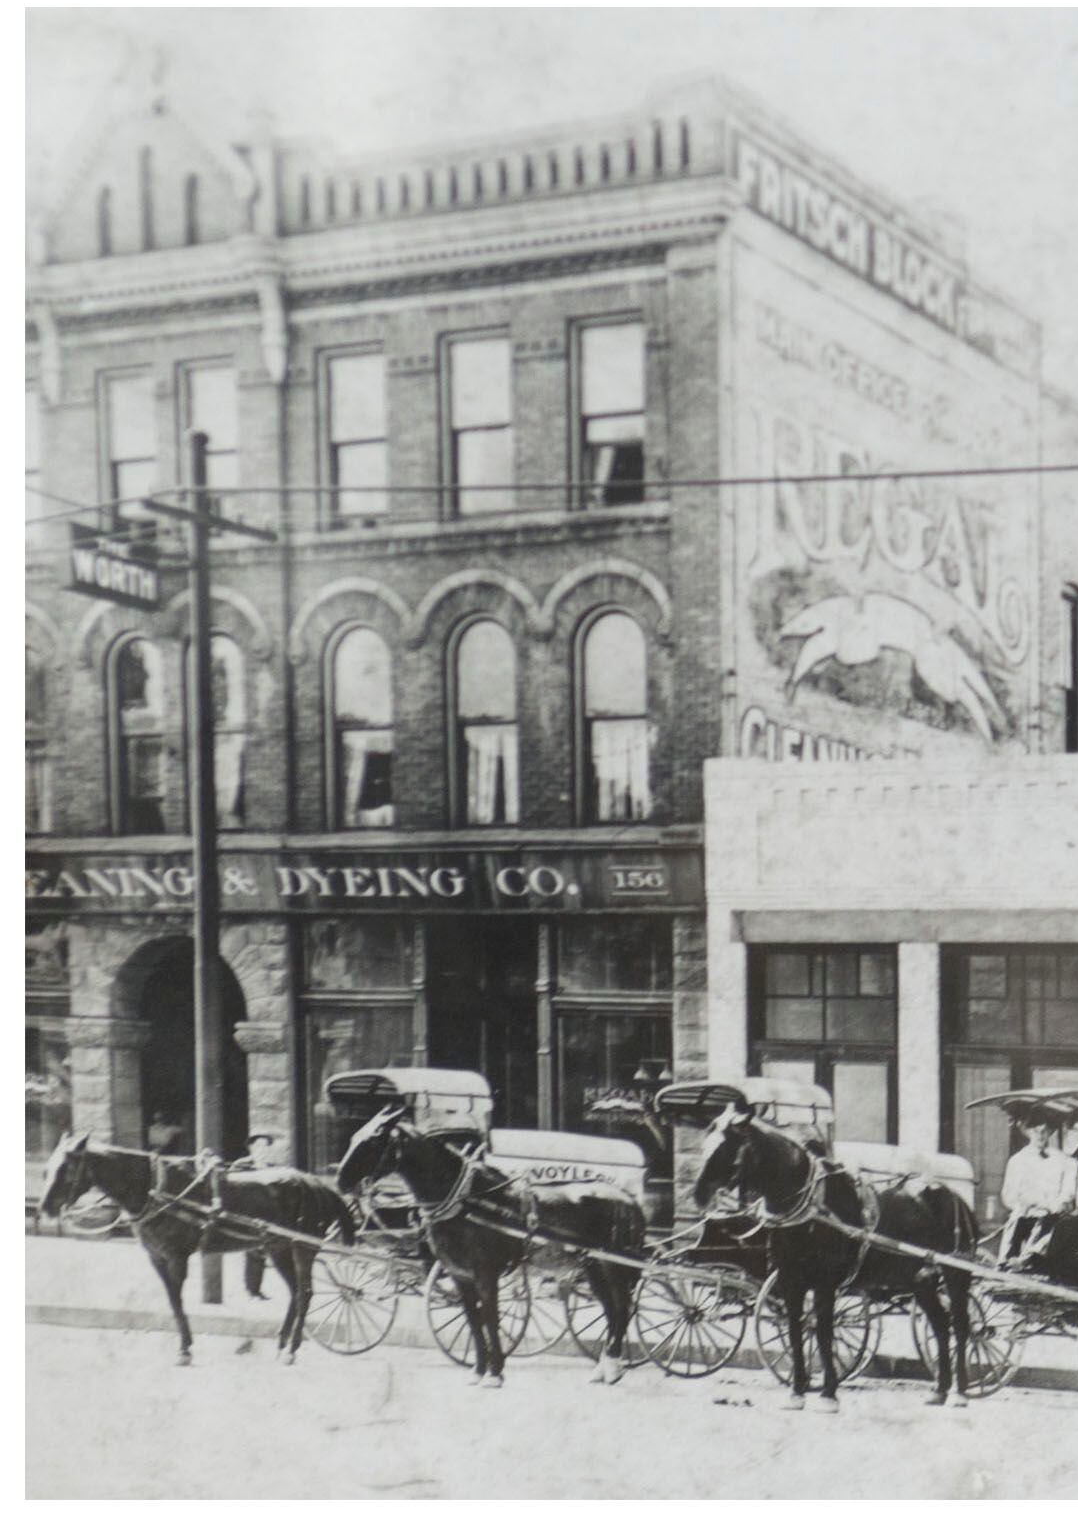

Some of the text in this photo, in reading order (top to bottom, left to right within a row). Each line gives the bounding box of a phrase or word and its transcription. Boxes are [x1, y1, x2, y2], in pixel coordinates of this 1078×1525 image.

[737, 137, 870, 278] FRITSCH
[872, 223, 958, 335] BLOCK
[73, 549, 158, 602] WORTH
[223, 867, 258, 896] &
[276, 867, 466, 898] DYEING
[496, 866, 581, 897] CO.
[614, 870, 665, 889] 156
